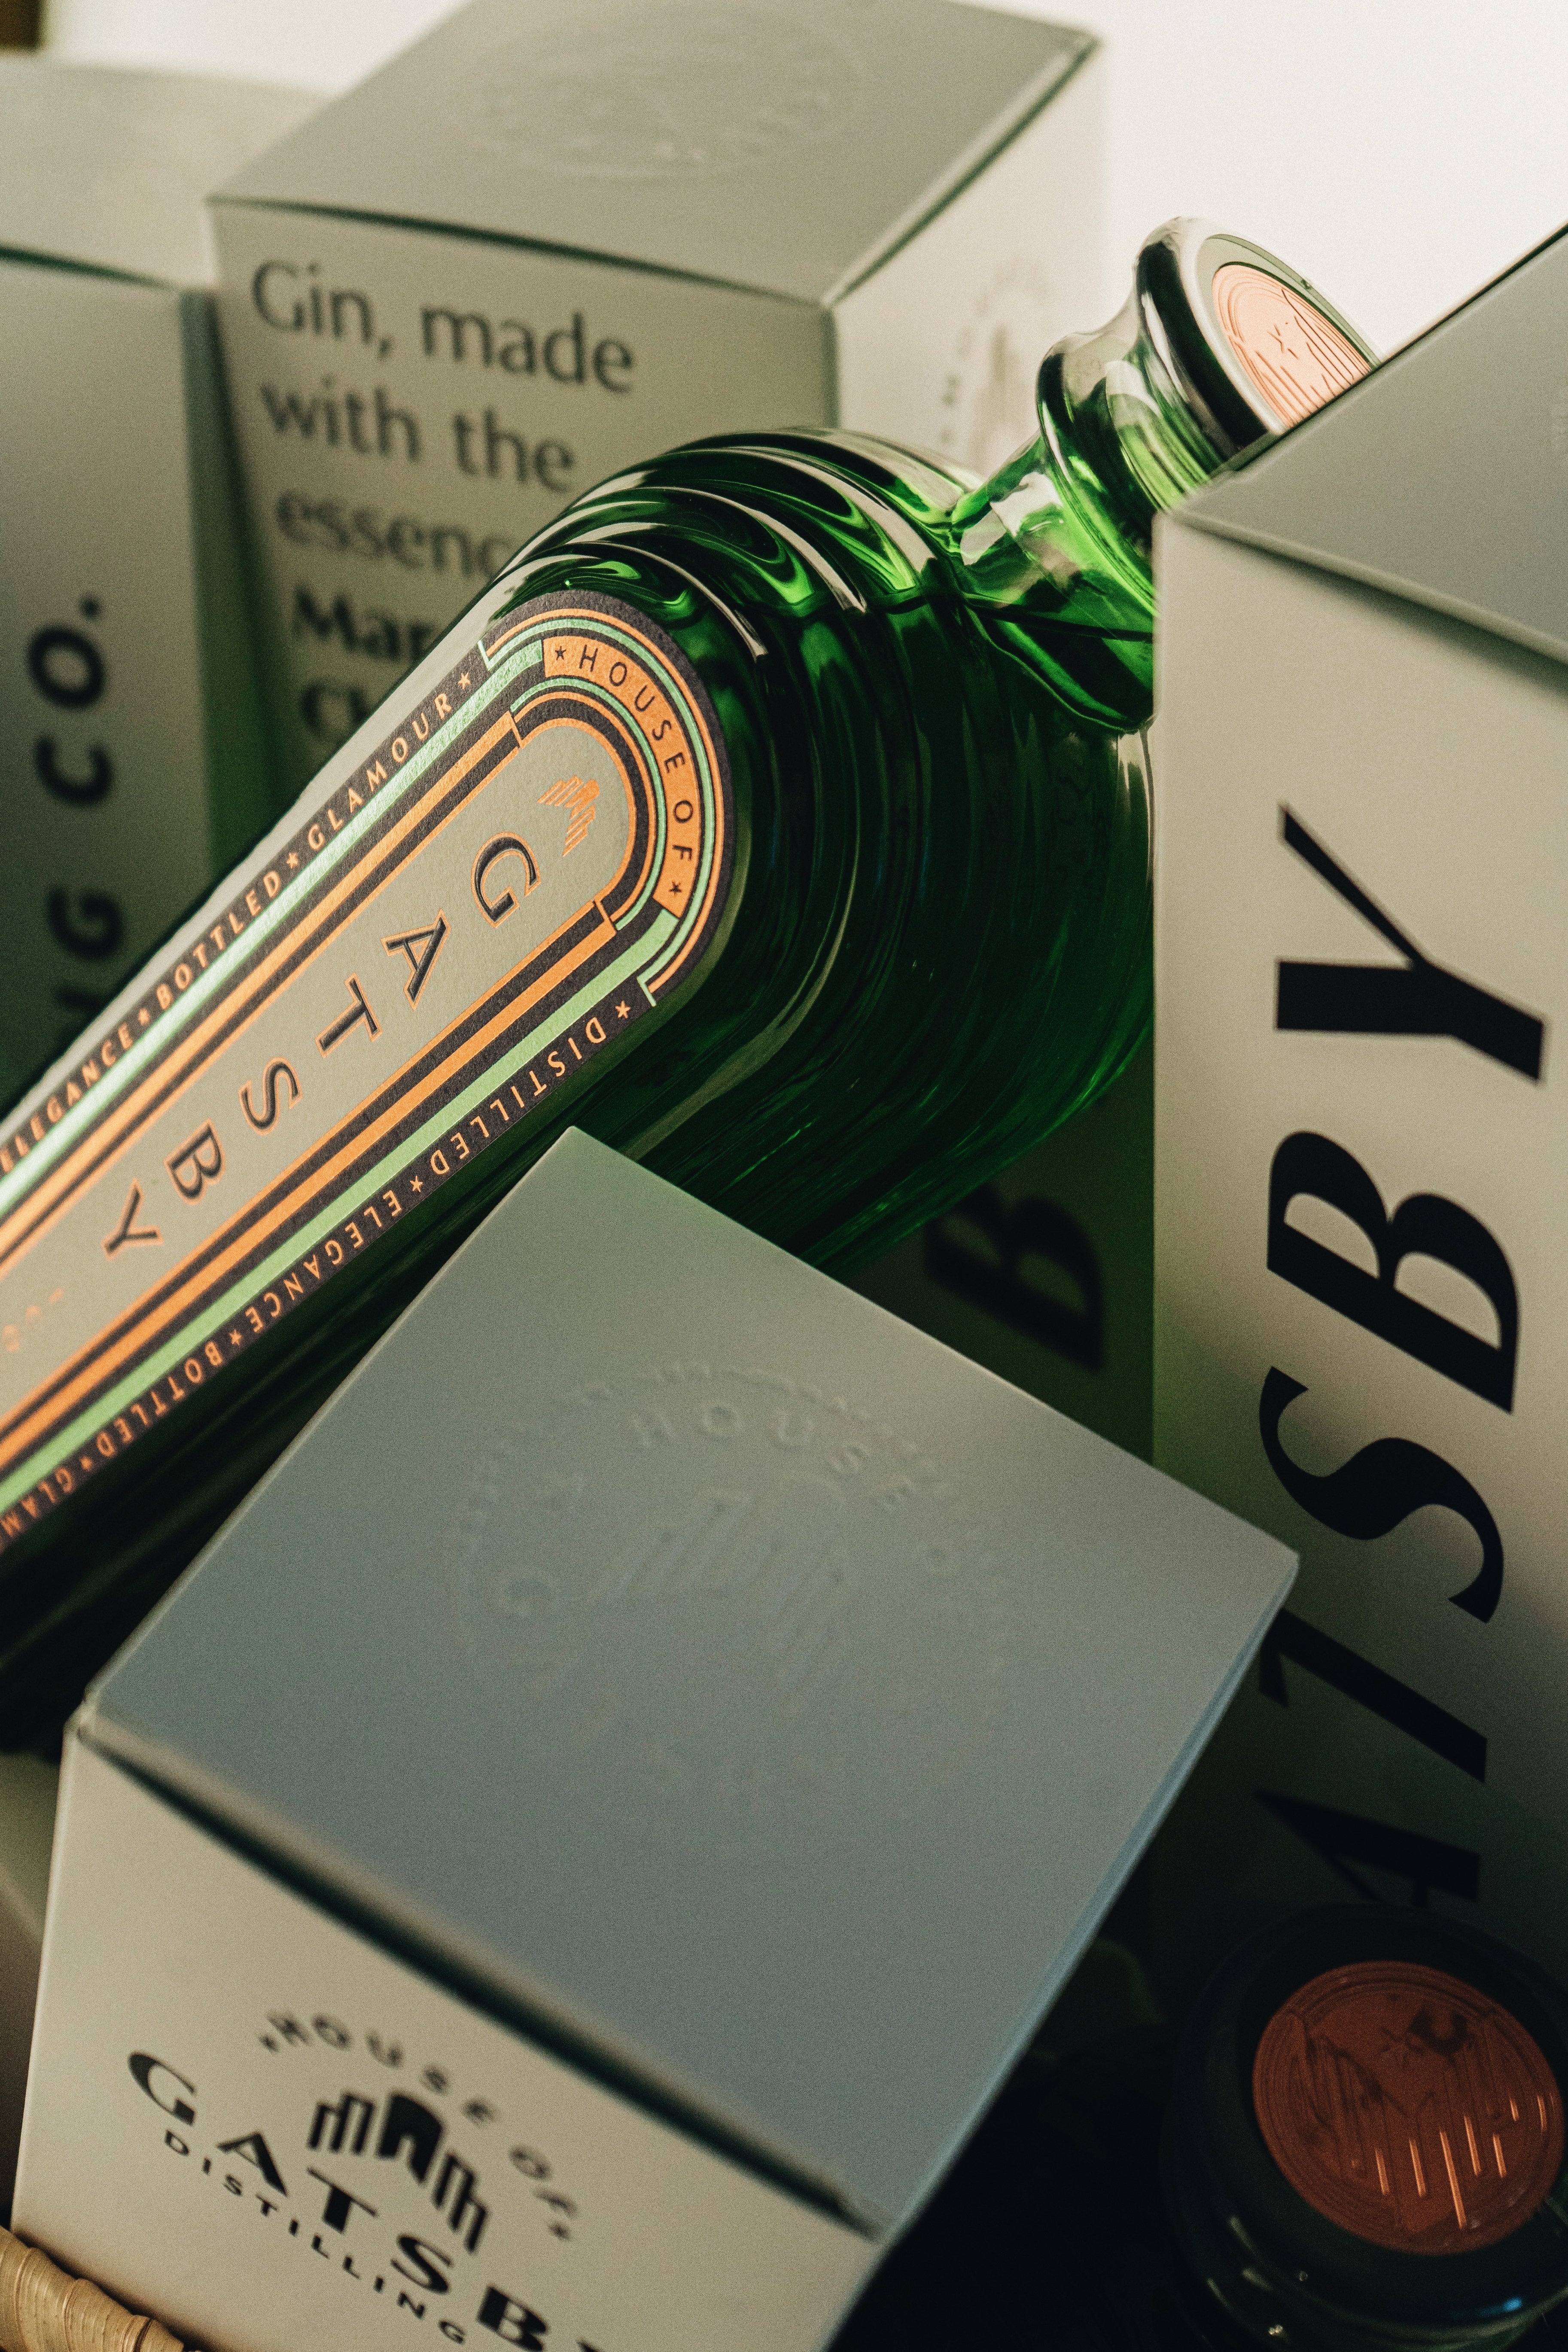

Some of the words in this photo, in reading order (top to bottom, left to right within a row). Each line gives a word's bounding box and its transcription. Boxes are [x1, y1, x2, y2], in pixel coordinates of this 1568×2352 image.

[252, 260, 392, 358] Gin,
[420, 310, 635, 393] made
[259, 374, 423, 463] with
[452, 406, 576, 493] the
[27, 593, 114, 808] CO.
[579, 644, 686, 773] HOUSE
[673, 799, 693, 861] OF
[156, 870, 282, 1010] BOTTLED
[308, 692, 452, 851] GLAMOUR
[101, 831, 541, 1261] GATSBY
[430, 1016, 607, 1175] DISTILLED
[244, 1190, 402, 1334] ELEGANCE
[96, 1341, 224, 1458] BOTTLED
[127, 2050, 608, 2352] GATSB
[163, 2129, 466, 2346] DISTILLING
